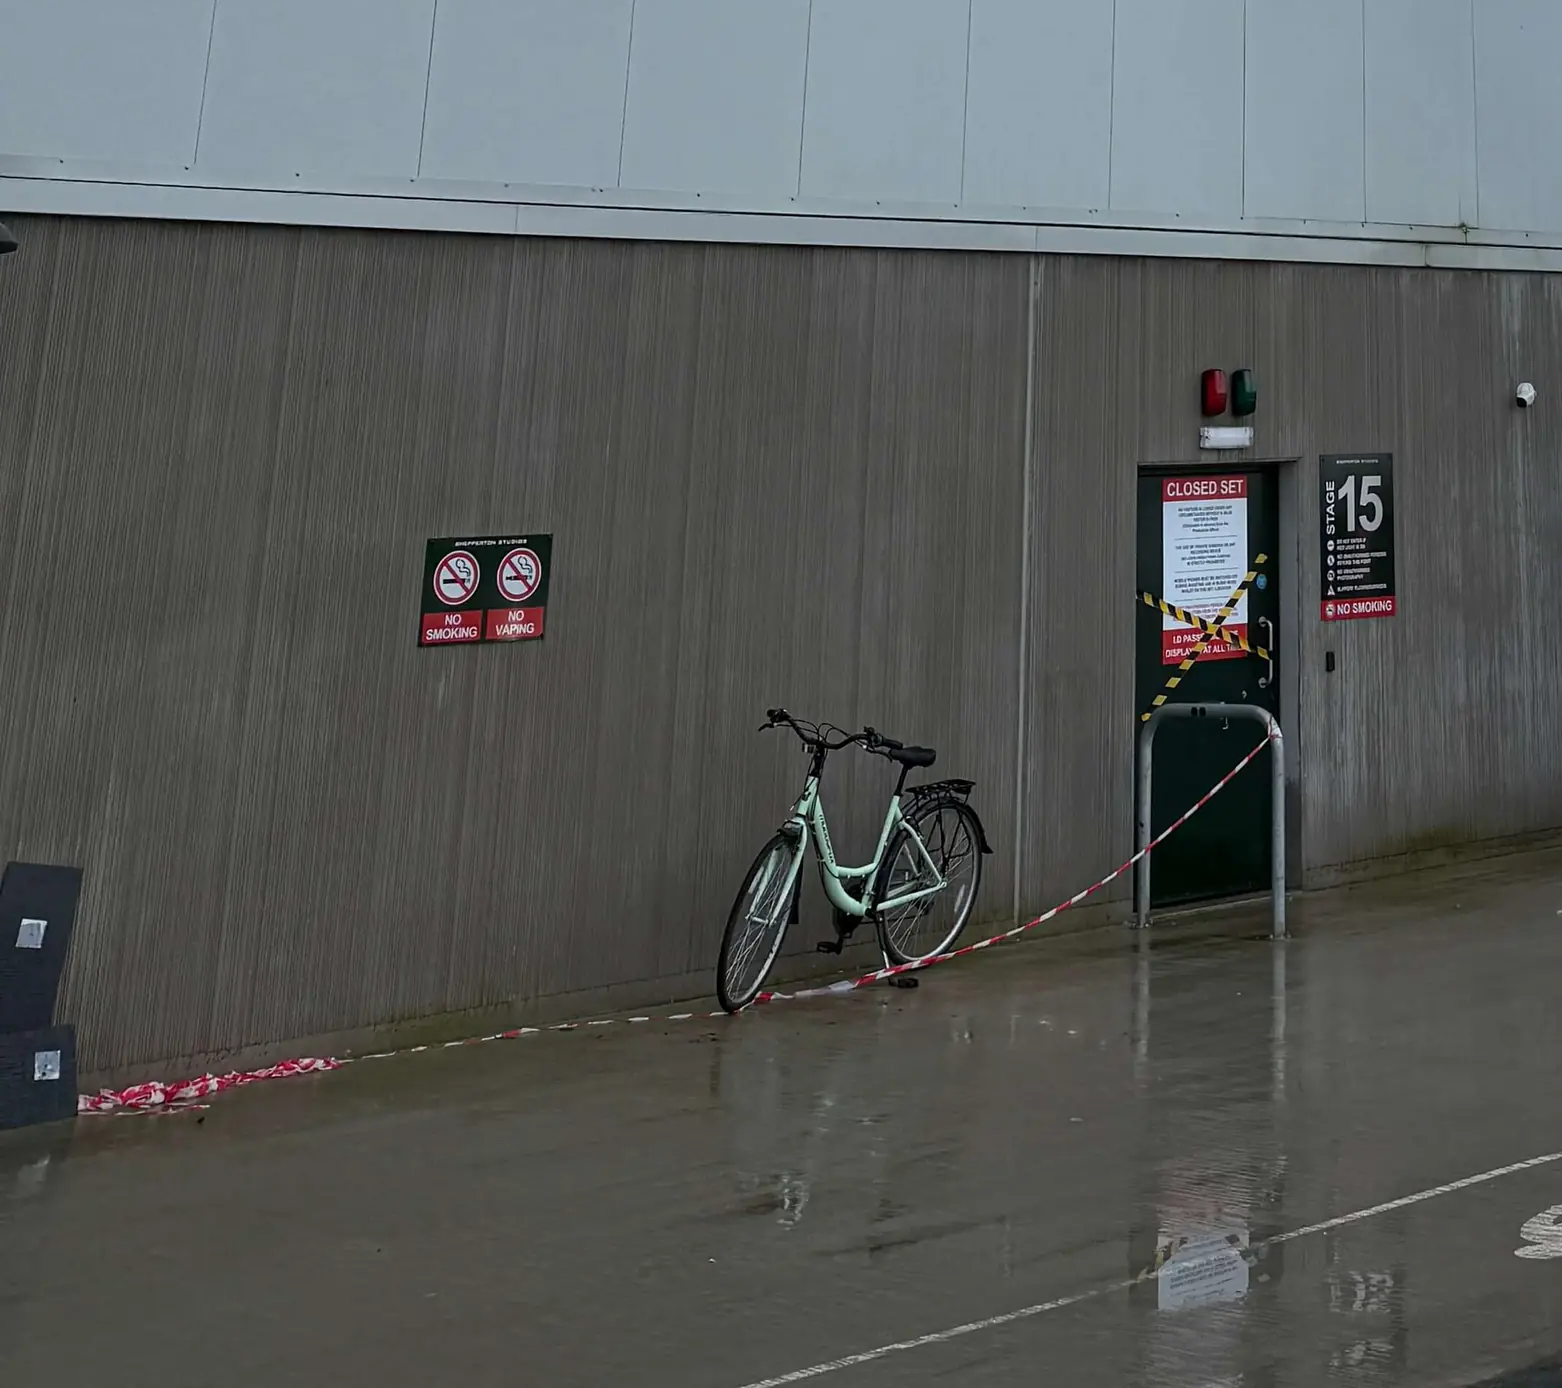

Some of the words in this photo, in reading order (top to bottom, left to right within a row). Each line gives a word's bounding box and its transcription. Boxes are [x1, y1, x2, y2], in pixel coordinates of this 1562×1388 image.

[1167, 480, 1217, 496] CLOSED
[1220, 479, 1244, 494] SET
[1325, 480, 1336, 535] STAGE
[1337, 474, 1384, 532] 15
[1337, 603, 1351, 615] NO
[1352, 600, 1392, 614] SMOKING
[445, 614, 462, 626] NO
[508, 610, 524, 622] NO
[426, 627, 478, 641] SMOKING
[495, 622, 535, 636] VAPING
[1212, 644, 1225, 654] ALL
